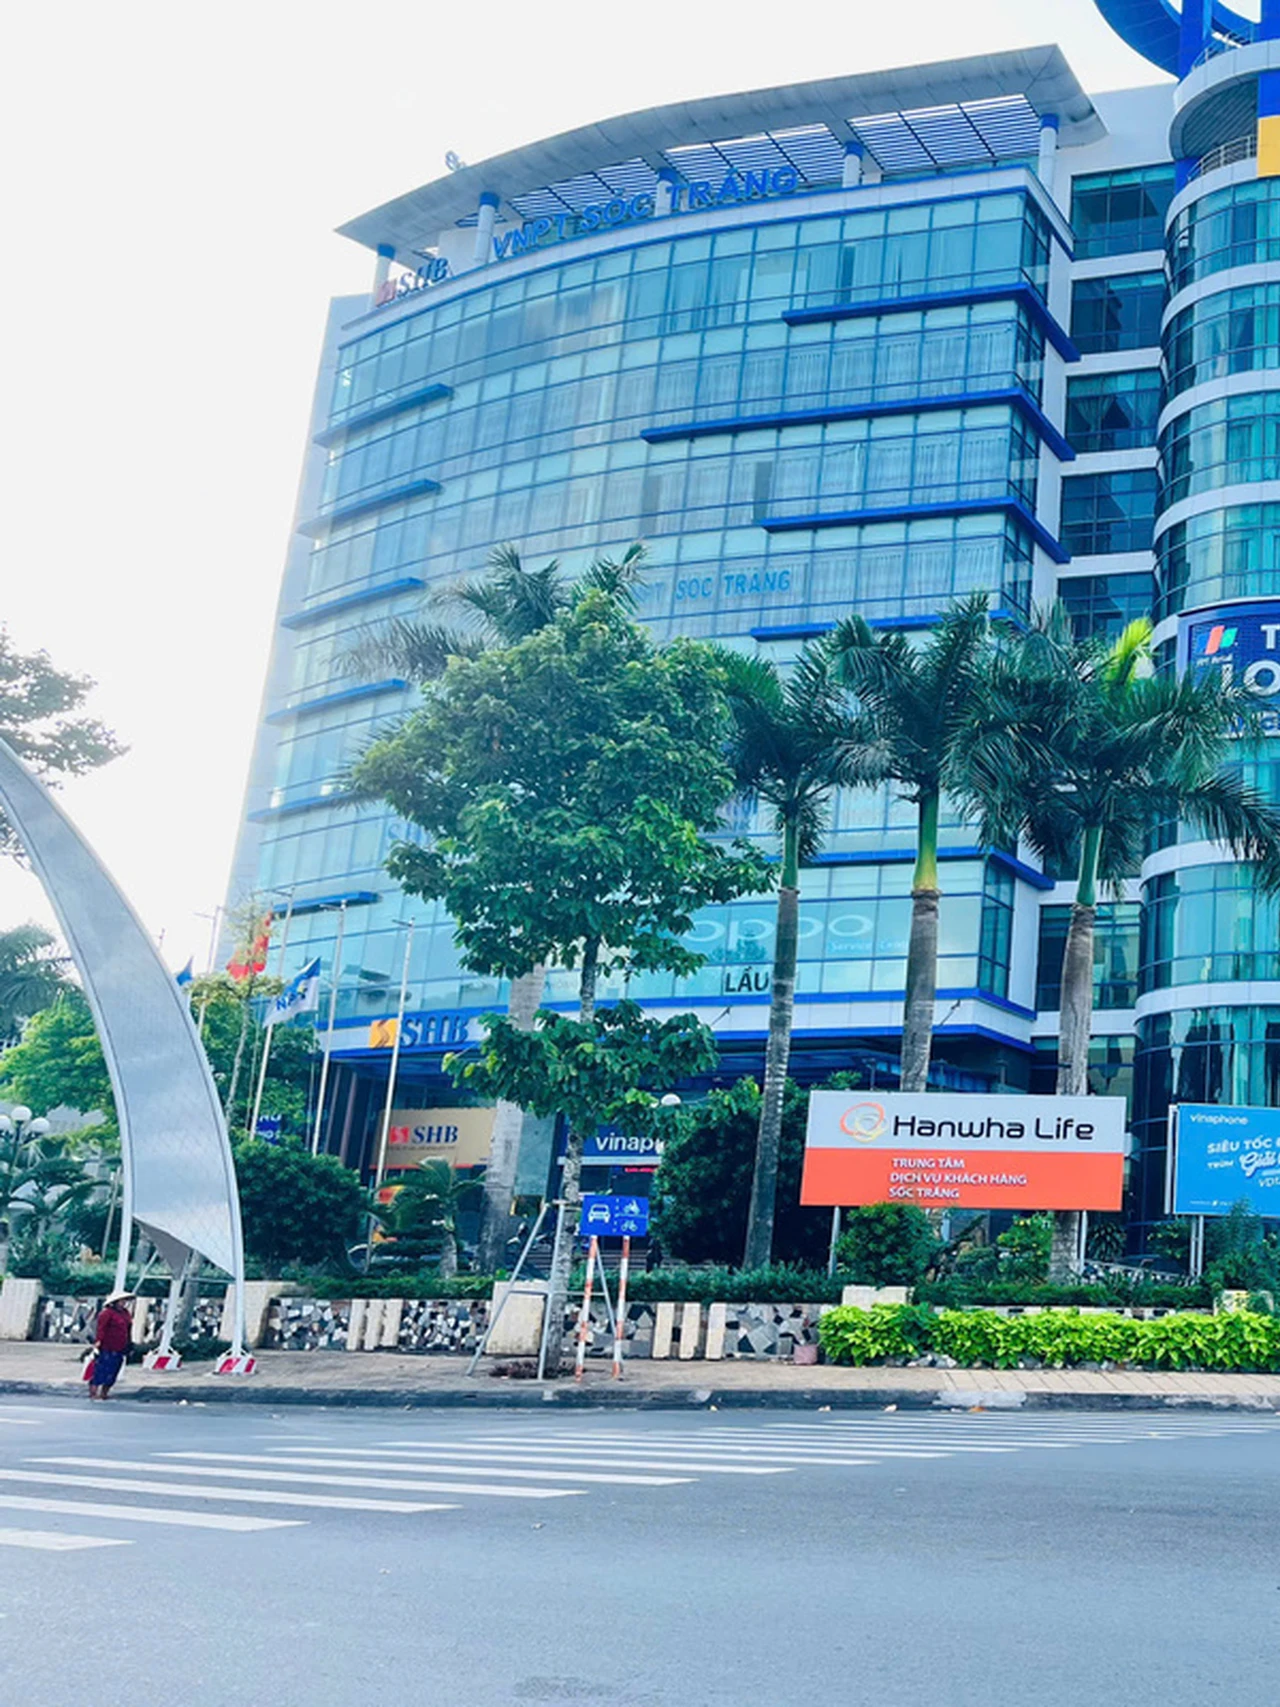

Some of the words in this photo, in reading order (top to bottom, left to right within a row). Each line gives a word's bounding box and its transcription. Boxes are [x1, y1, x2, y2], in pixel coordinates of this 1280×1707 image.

[493, 212, 568, 257] VNPT
[398, 258, 448, 298] SHB
[401, 1017, 468, 1047] SHB
[893, 1115, 1024, 1139] Hanwha
[1035, 1117, 1094, 1140] Life
[1190, 1114, 1248, 1125] vinaphone
[412, 1125, 458, 1144] SHB
[595, 1132, 664, 1153] vinap
[1207, 1140, 1240, 1154] SIÊU
[1243, 1135, 1273, 1150] TỐC
[893, 1158, 936, 1169] TRUNG
[938, 1157, 965, 1169] TÂM
[890, 1173, 921, 1184] DỊCH
[923, 1174, 942, 1185] VỤ
[944, 1173, 987, 1185] KHÁCH
[989, 1174, 1027, 1186] HÀNG
[889, 1186, 914, 1198] SÓC
